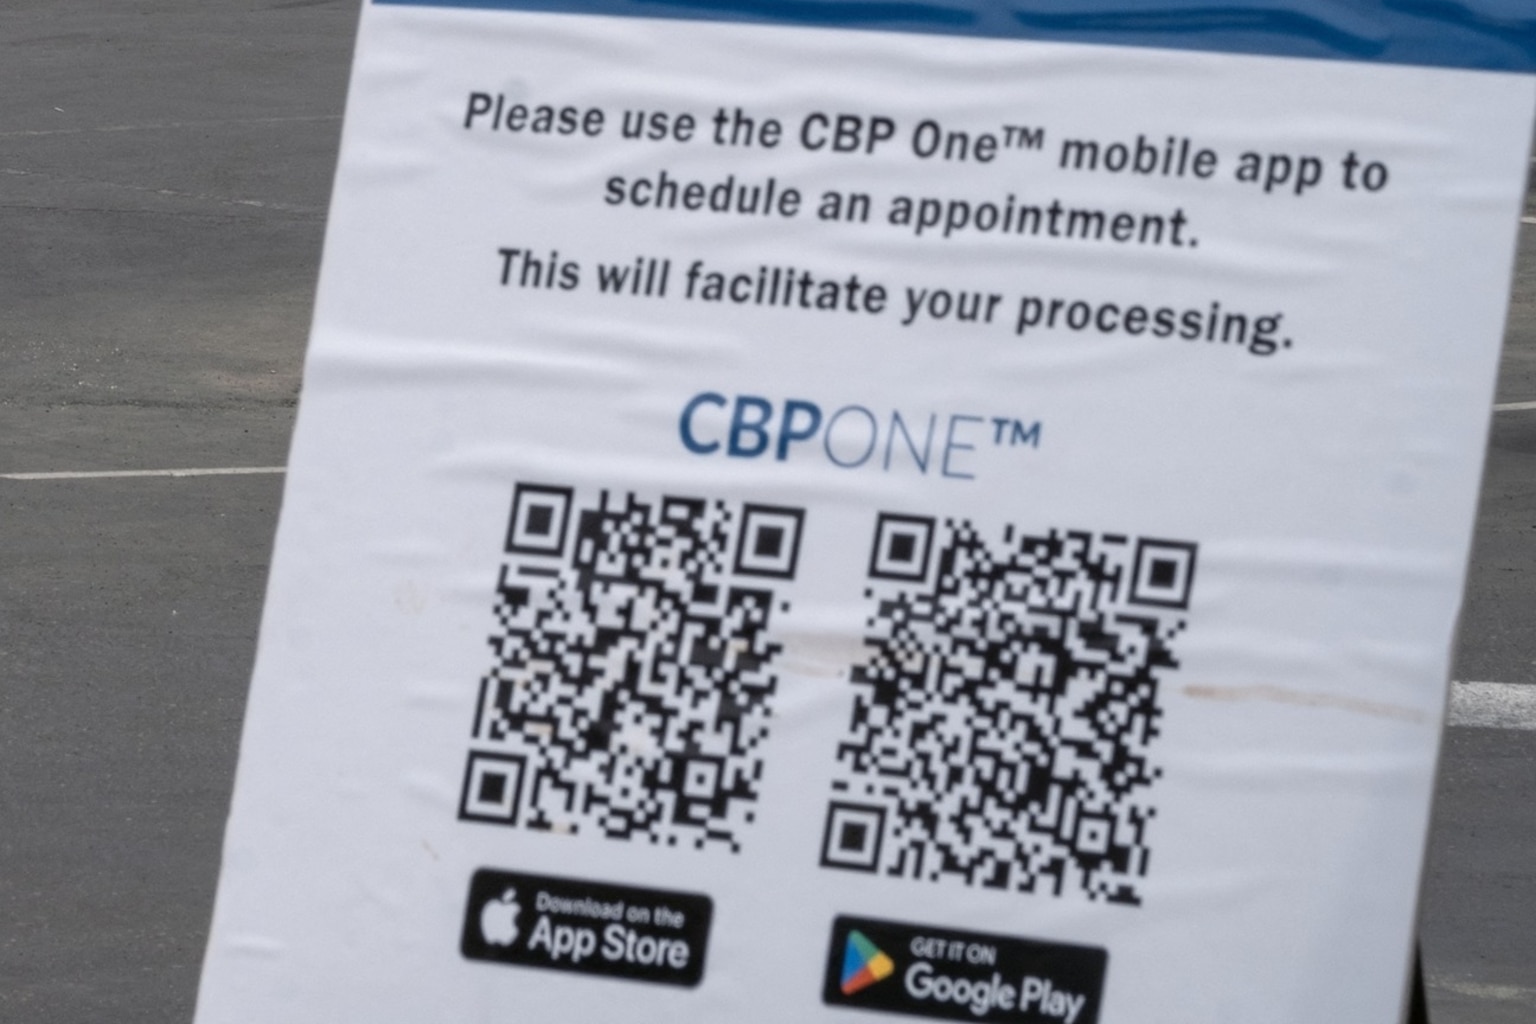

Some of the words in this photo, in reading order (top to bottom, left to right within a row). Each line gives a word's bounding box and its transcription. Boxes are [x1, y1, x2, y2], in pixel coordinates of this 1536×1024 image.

[463, 91, 606, 137] Please
[621, 109, 696, 142] use
[712, 107, 783, 150] the
[799, 112, 896, 155] CBP
[1059, 135, 1218, 178] mobile
[1235, 150, 1324, 196] app
[1342, 150, 1390, 192] to
[603, 170, 802, 219] schedule
[817, 189, 871, 223] an
[886, 193, 1199, 247] appointment.
[497, 248, 581, 291] This
[597, 256, 671, 298] will
[684, 260, 888, 315] facilitate
[901, 285, 1003, 326] your
[1015, 300, 1293, 357] processing.
[535, 891, 624, 921] Download
[626, 906, 650, 925] on
[653, 906, 685, 929] the
[527, 914, 597, 963] App
[601, 922, 690, 970] Store
[910, 936, 947, 960] GET
[948, 940, 965, 961] IT
[966, 942, 997, 966] ON
[904, 961, 1017, 1017] Google
[1019, 975, 1086, 1024] Play
